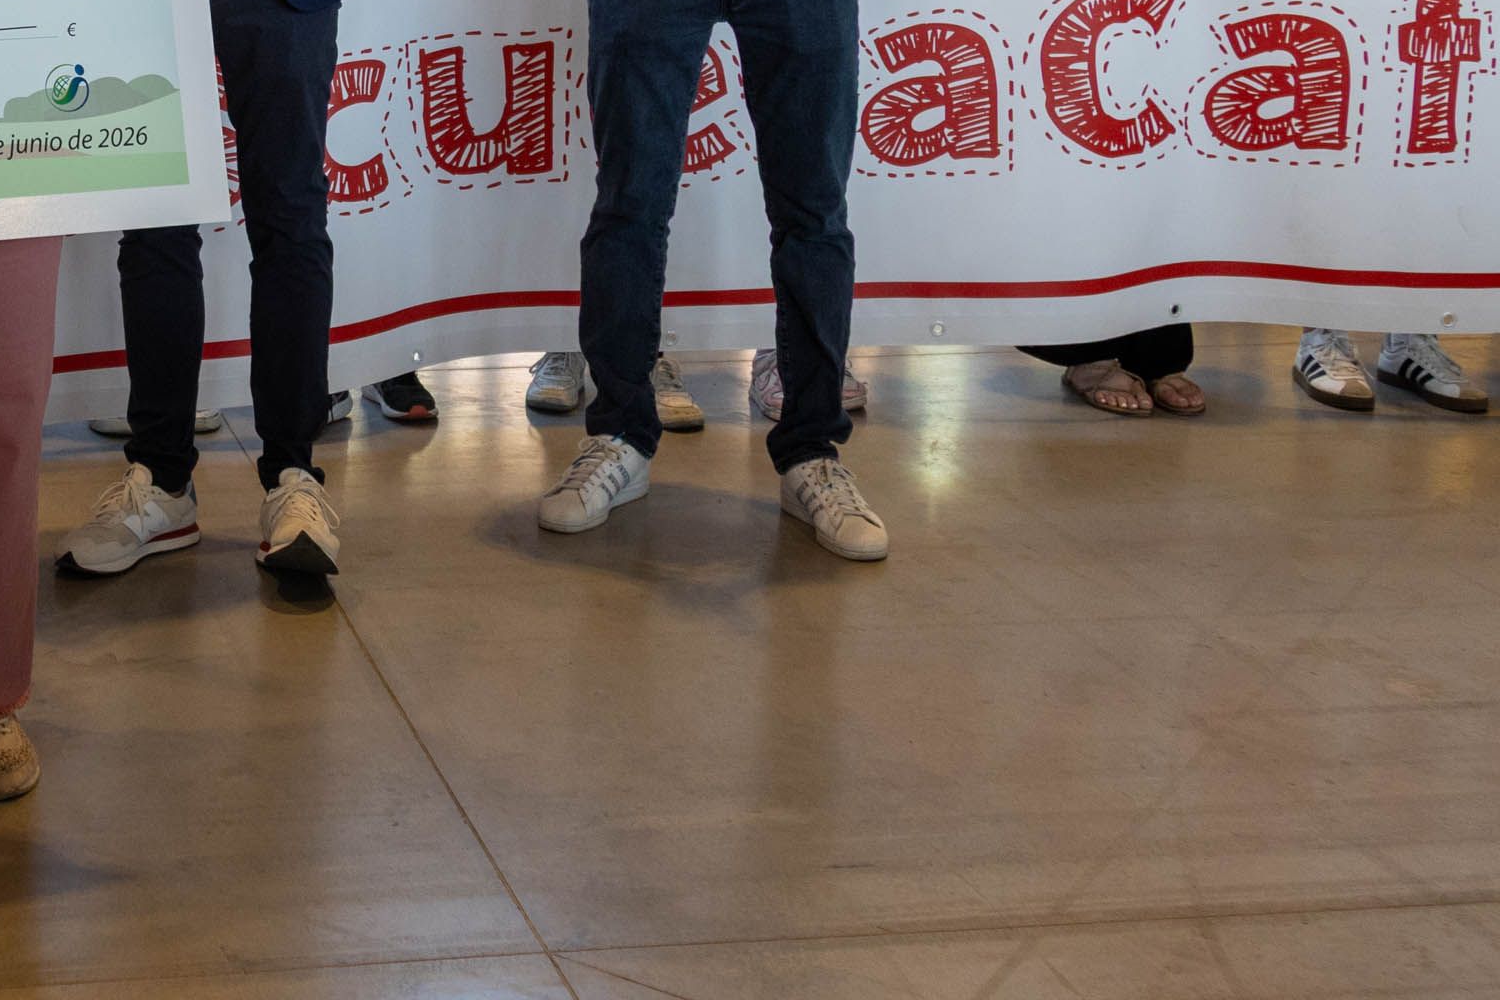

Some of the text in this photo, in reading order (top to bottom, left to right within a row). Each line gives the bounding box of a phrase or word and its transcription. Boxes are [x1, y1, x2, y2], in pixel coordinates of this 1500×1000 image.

[67, 22, 77, 38] €
[7, 132, 63, 160] junio
[68, 128, 93, 151] de
[98, 126, 148, 149] 2026
